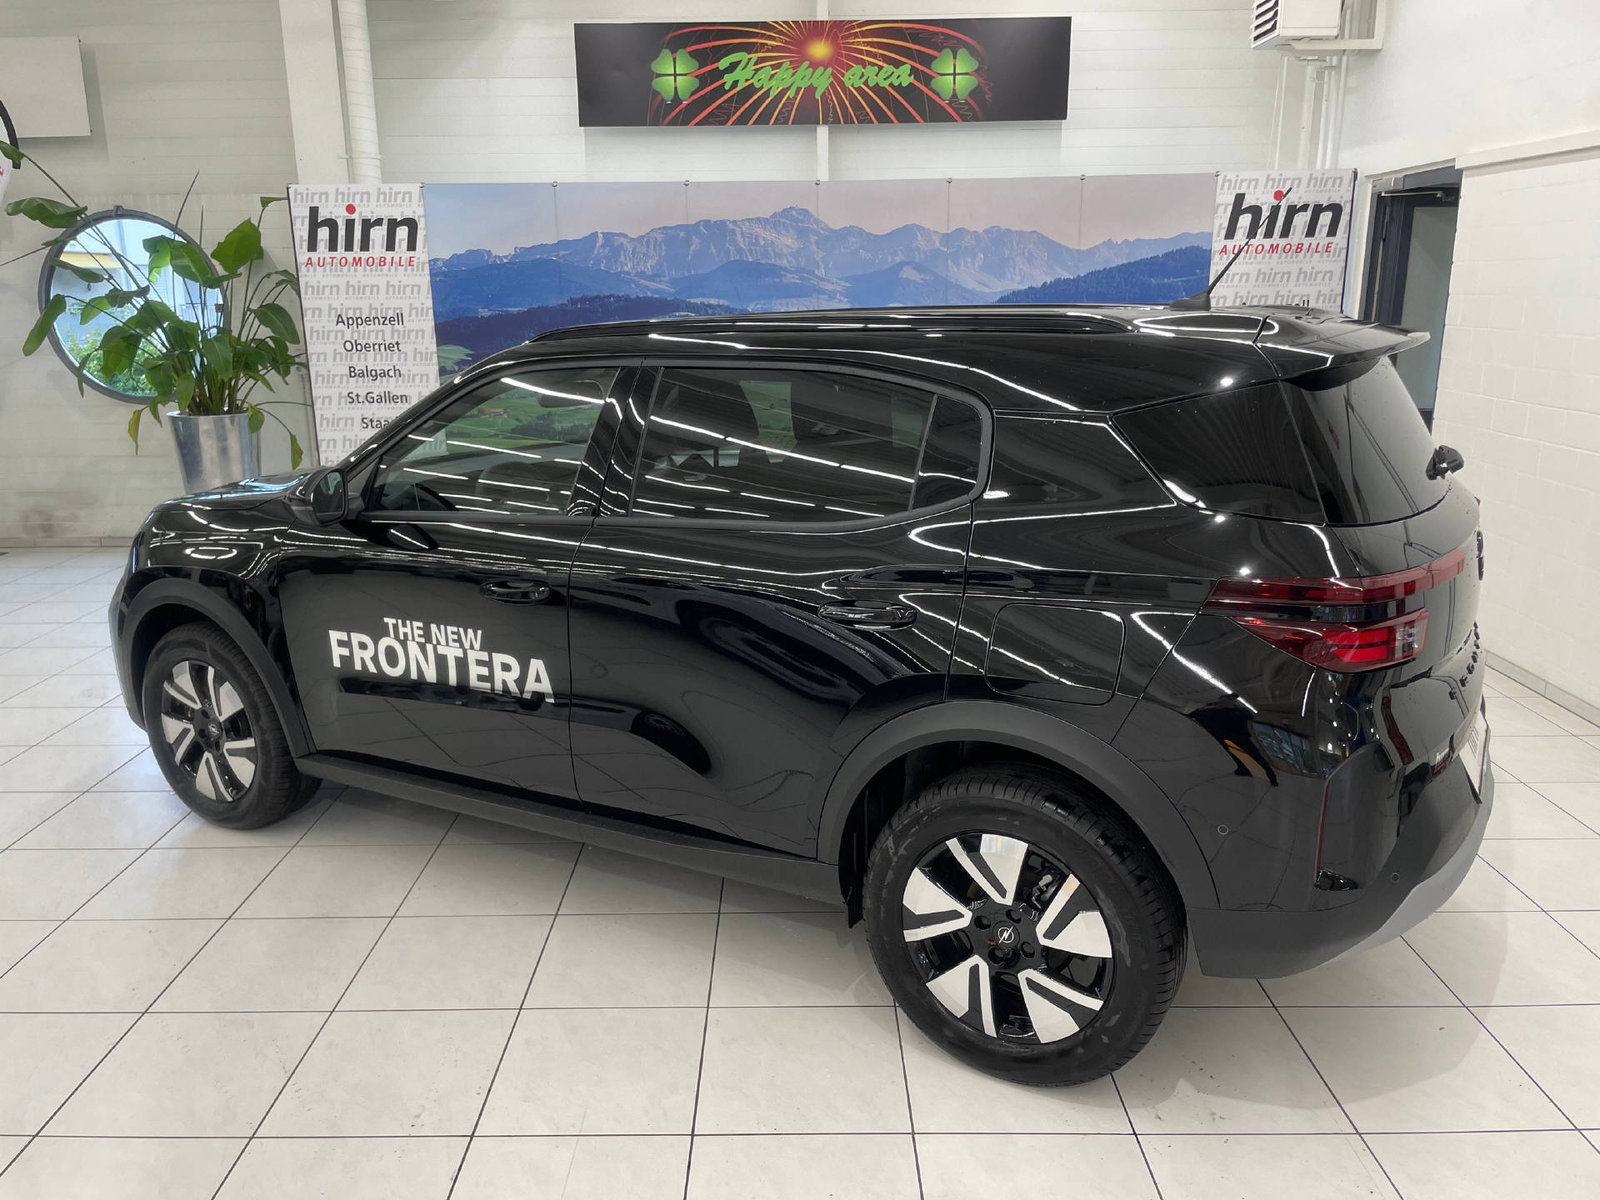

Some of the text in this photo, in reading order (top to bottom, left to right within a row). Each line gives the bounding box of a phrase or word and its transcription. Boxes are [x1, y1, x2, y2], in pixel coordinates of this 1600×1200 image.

[718, 51, 914, 99] Happy area
[1307, 172, 1344, 188] hirn
[293, 187, 412, 203] hirn hirn hirn
[1223, 189, 1344, 241] hirn
[307, 203, 418, 252] hirn
[1218, 242, 1334, 256] AUTOMOBILE
[304, 256, 416, 268] AUTOMOBILE
[1254, 267, 1291, 283] hirn
[1296, 266, 1334, 282] hirn
[304, 280, 421, 296] hirn hirn hirn
[335, 313, 404, 330] Appenzell
[343, 340, 402, 353] Oberriet
[348, 365, 403, 382] Balgach
[347, 391, 409, 405] St.Gallen
[361, 416, 392, 429] Staa
[383, 617, 482, 650] THE NEW
[328, 630, 555, 704] FRONTERA
